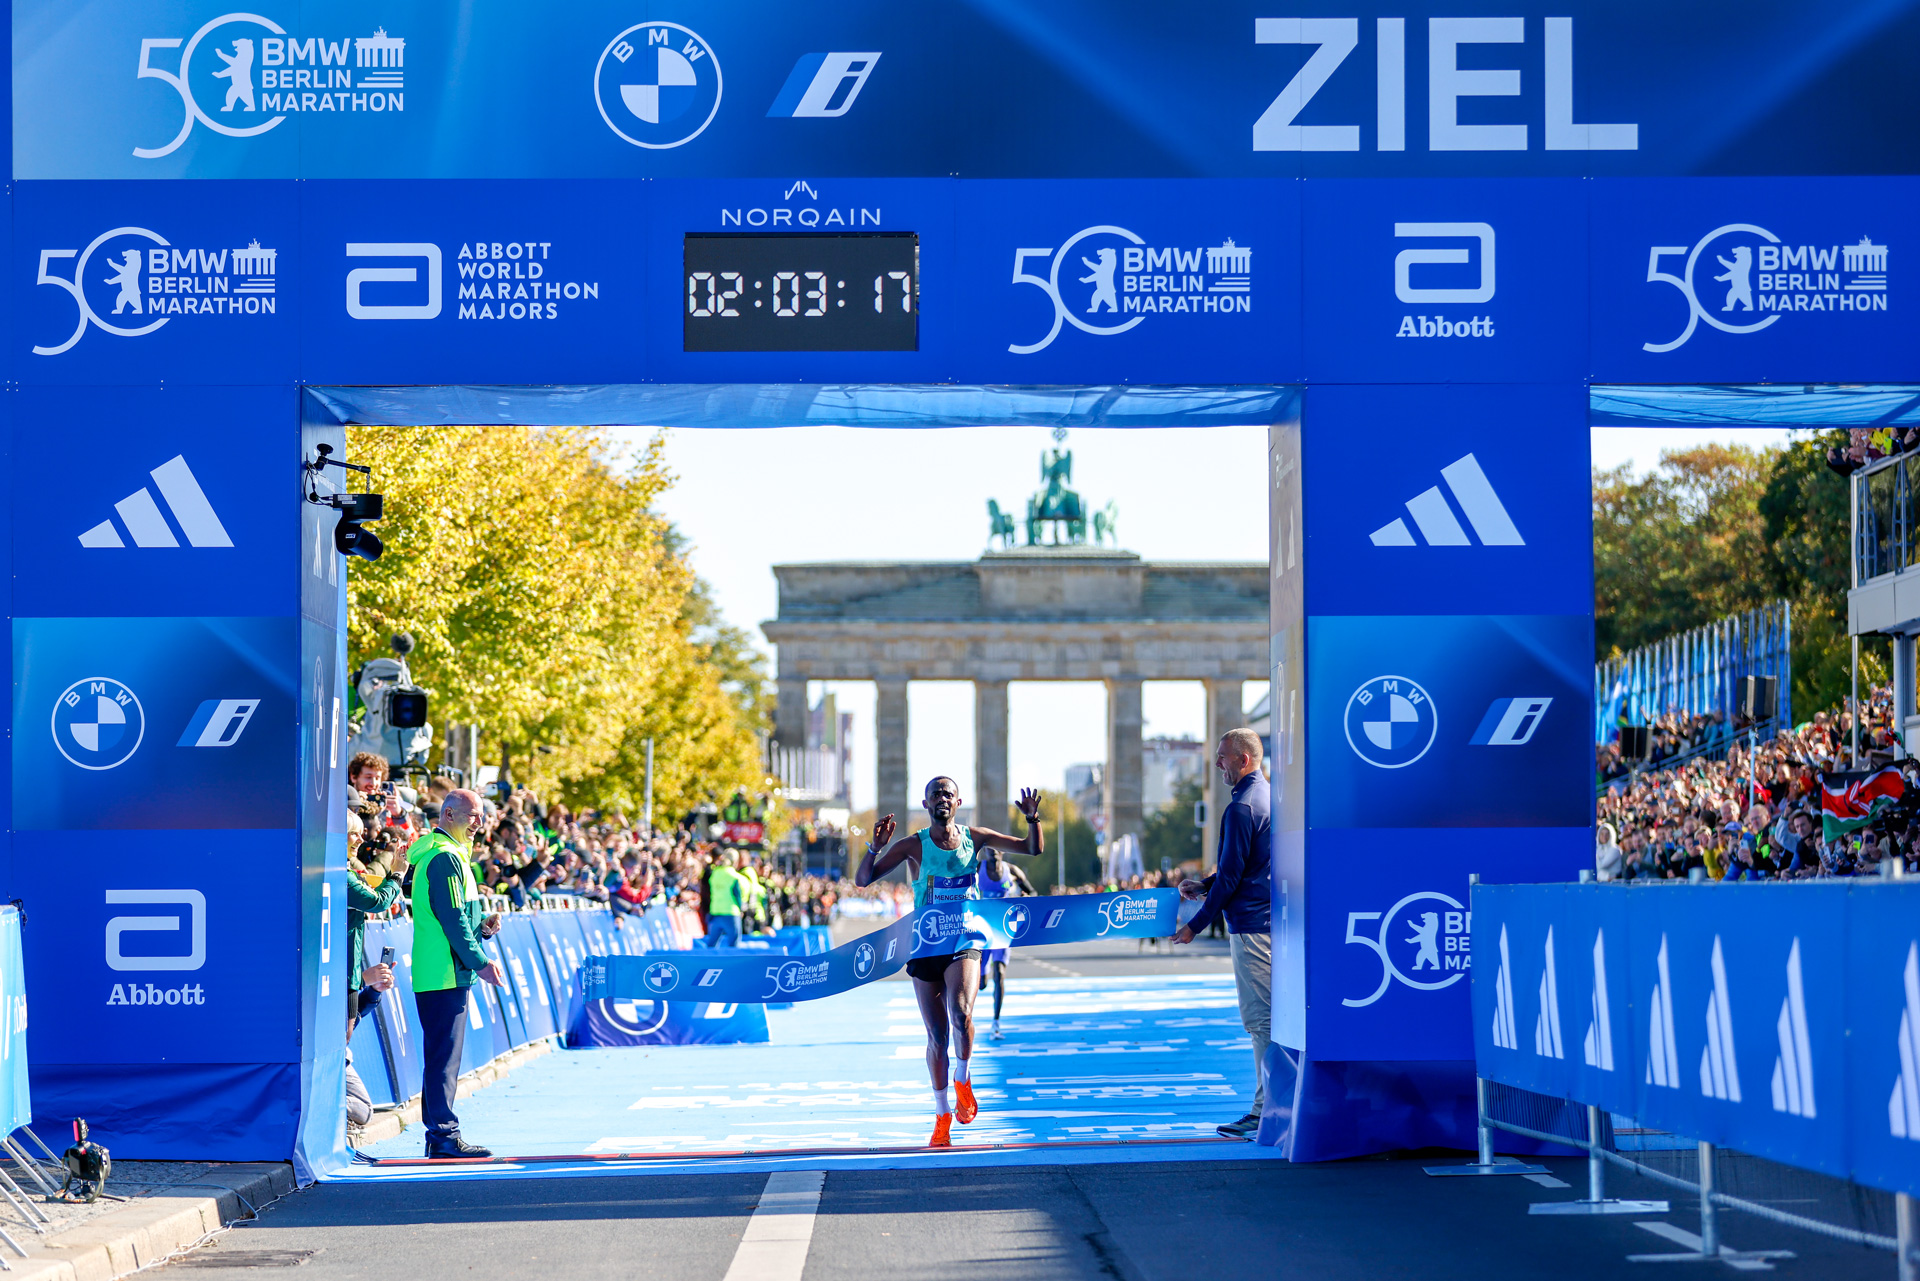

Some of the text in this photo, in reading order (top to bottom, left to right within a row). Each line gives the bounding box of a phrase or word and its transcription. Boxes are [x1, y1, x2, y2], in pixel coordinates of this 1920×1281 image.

[262, 38, 350, 66] BMW
[612, 28, 705, 63] BMW
[262, 70, 351, 88] BERLIN
[1253, 17, 1638, 151] ZIEL
[262, 93, 403, 111] MARATHON
[722, 208, 880, 227] NORQAIN
[458, 243, 551, 259] ABBOTT
[1758, 246, 1838, 270] BMW
[149, 249, 227, 273] BMW
[1123, 248, 1202, 272] BMW
[458, 263, 543, 279] WORLD
[149, 279, 228, 293] BERLIN
[458, 283, 599, 299] MARATHON
[1123, 276, 1203, 292] BERLIN
[1758, 275, 1839, 290] BERLIN
[149, 297, 275, 314] MARATHON
[458, 303, 557, 319] MAJORS
[1123, 296, 1250, 312] MARATHON
[1758, 294, 1887, 311] MARATHON
[1396, 315, 1494, 337] Abbott
[65, 683, 132, 707] BMW
[1358, 681, 1425, 705] BMW
[1125, 900, 1145, 909] BMW
[938, 913, 964, 924] BMW
[939, 922, 965, 930] BERLIN
[1445, 911, 1471, 933] B
[939, 928, 977, 937] MARATHON
[796, 972, 818, 981] BERLIN
[797, 964, 819, 975] BMW
[795, 976, 828, 987] MARATHON
[107, 983, 206, 1005] Abbott
